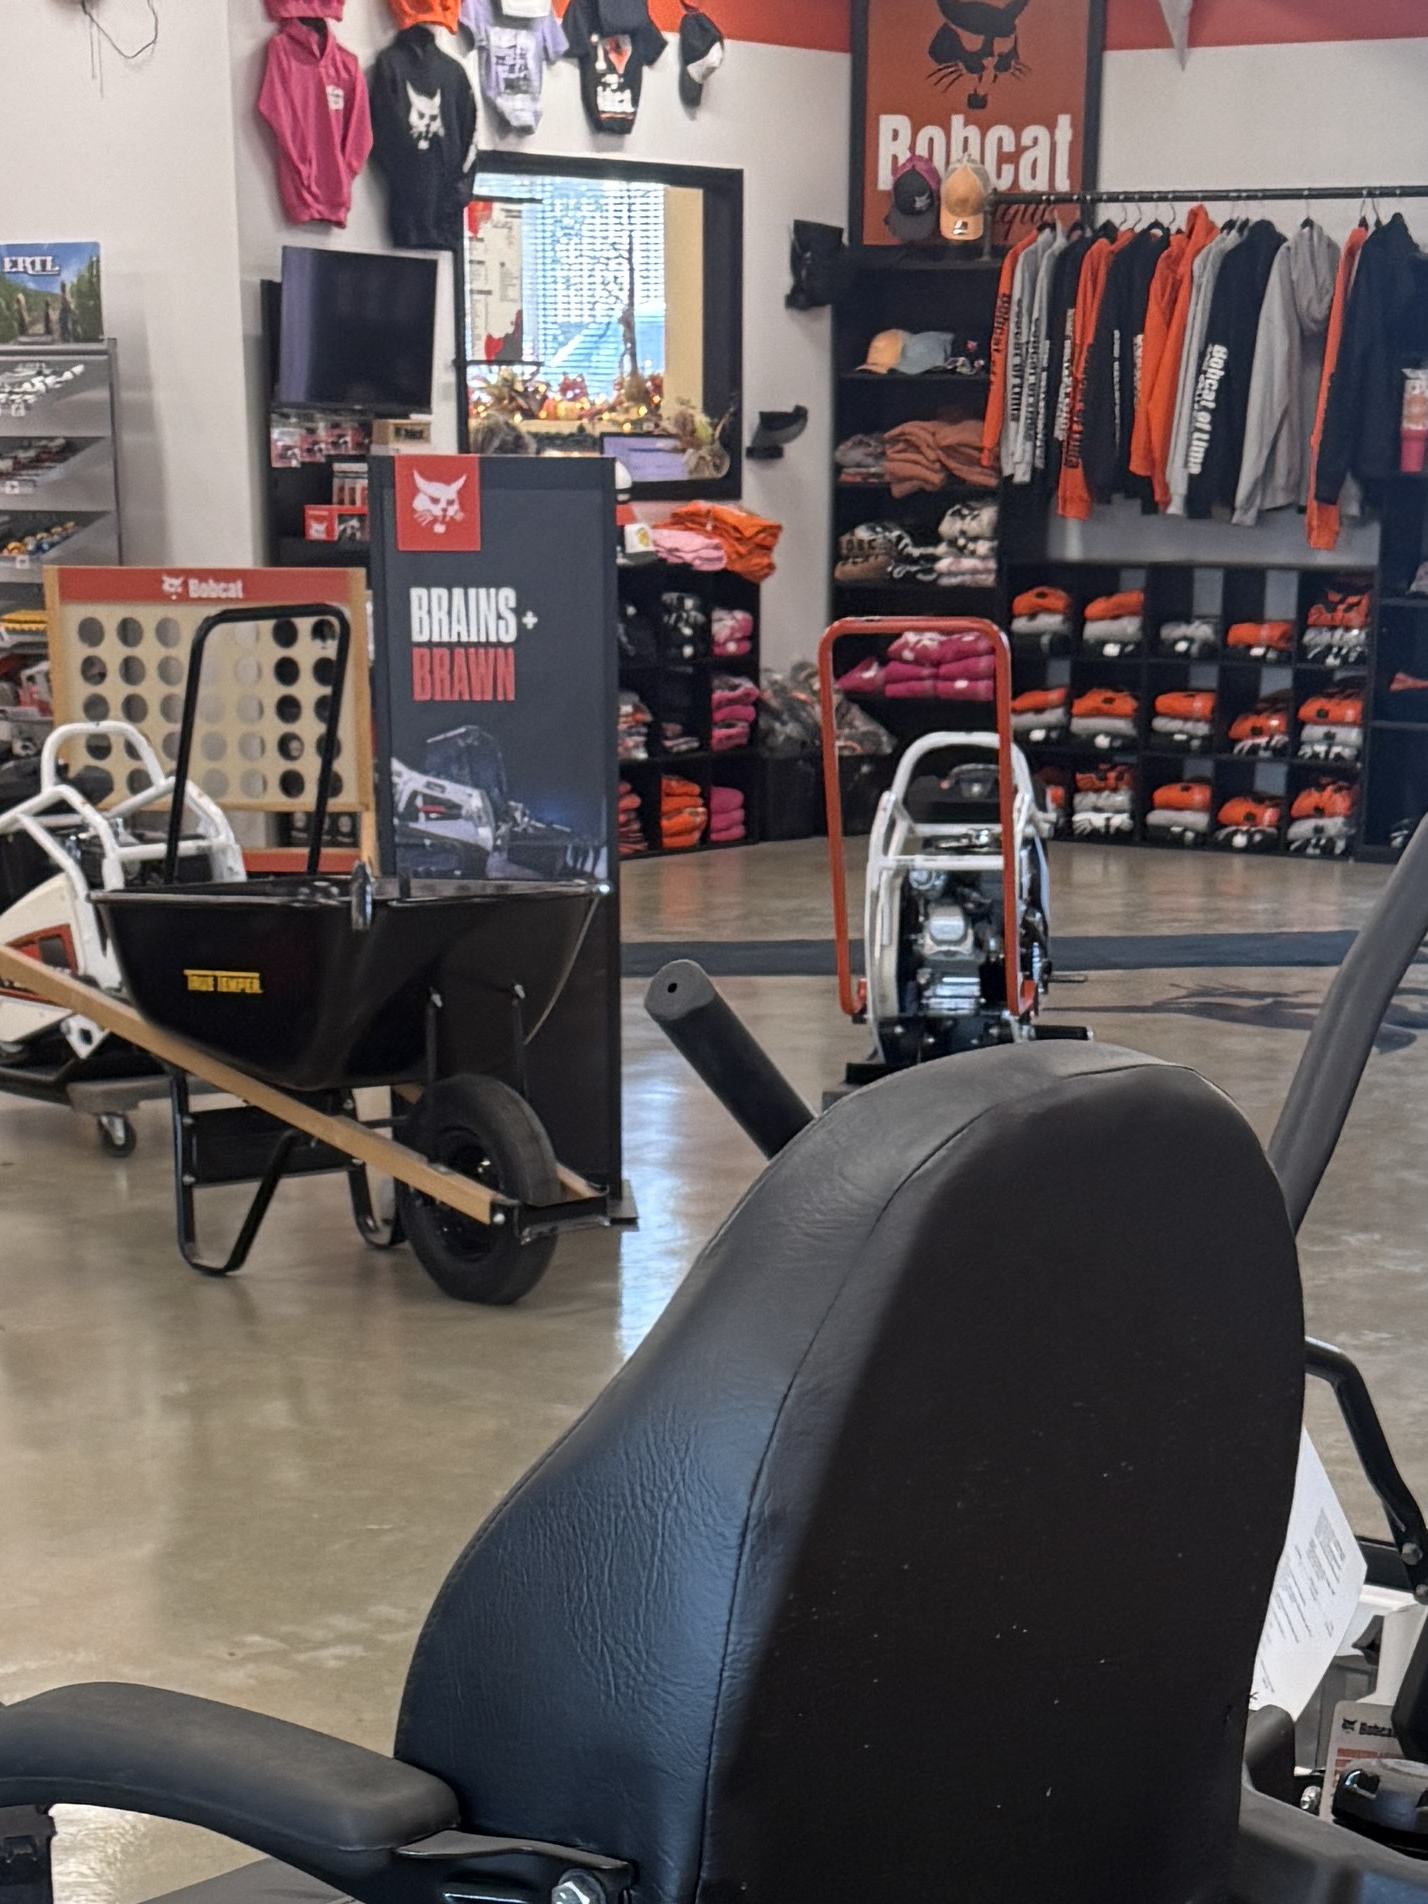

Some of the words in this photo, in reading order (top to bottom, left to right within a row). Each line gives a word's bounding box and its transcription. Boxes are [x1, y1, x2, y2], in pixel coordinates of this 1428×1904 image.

[876, 113, 1074, 192] Bobcat
[2, 255, 61, 275] ERTL
[1197, 342, 1228, 410] Bobcat
[187, 576, 244, 600] Bobcat
[409, 586, 518, 644] BRAINS
[411, 647, 517, 702] BRAWN
[1358, 1721, 1392, 1738] Bobca
